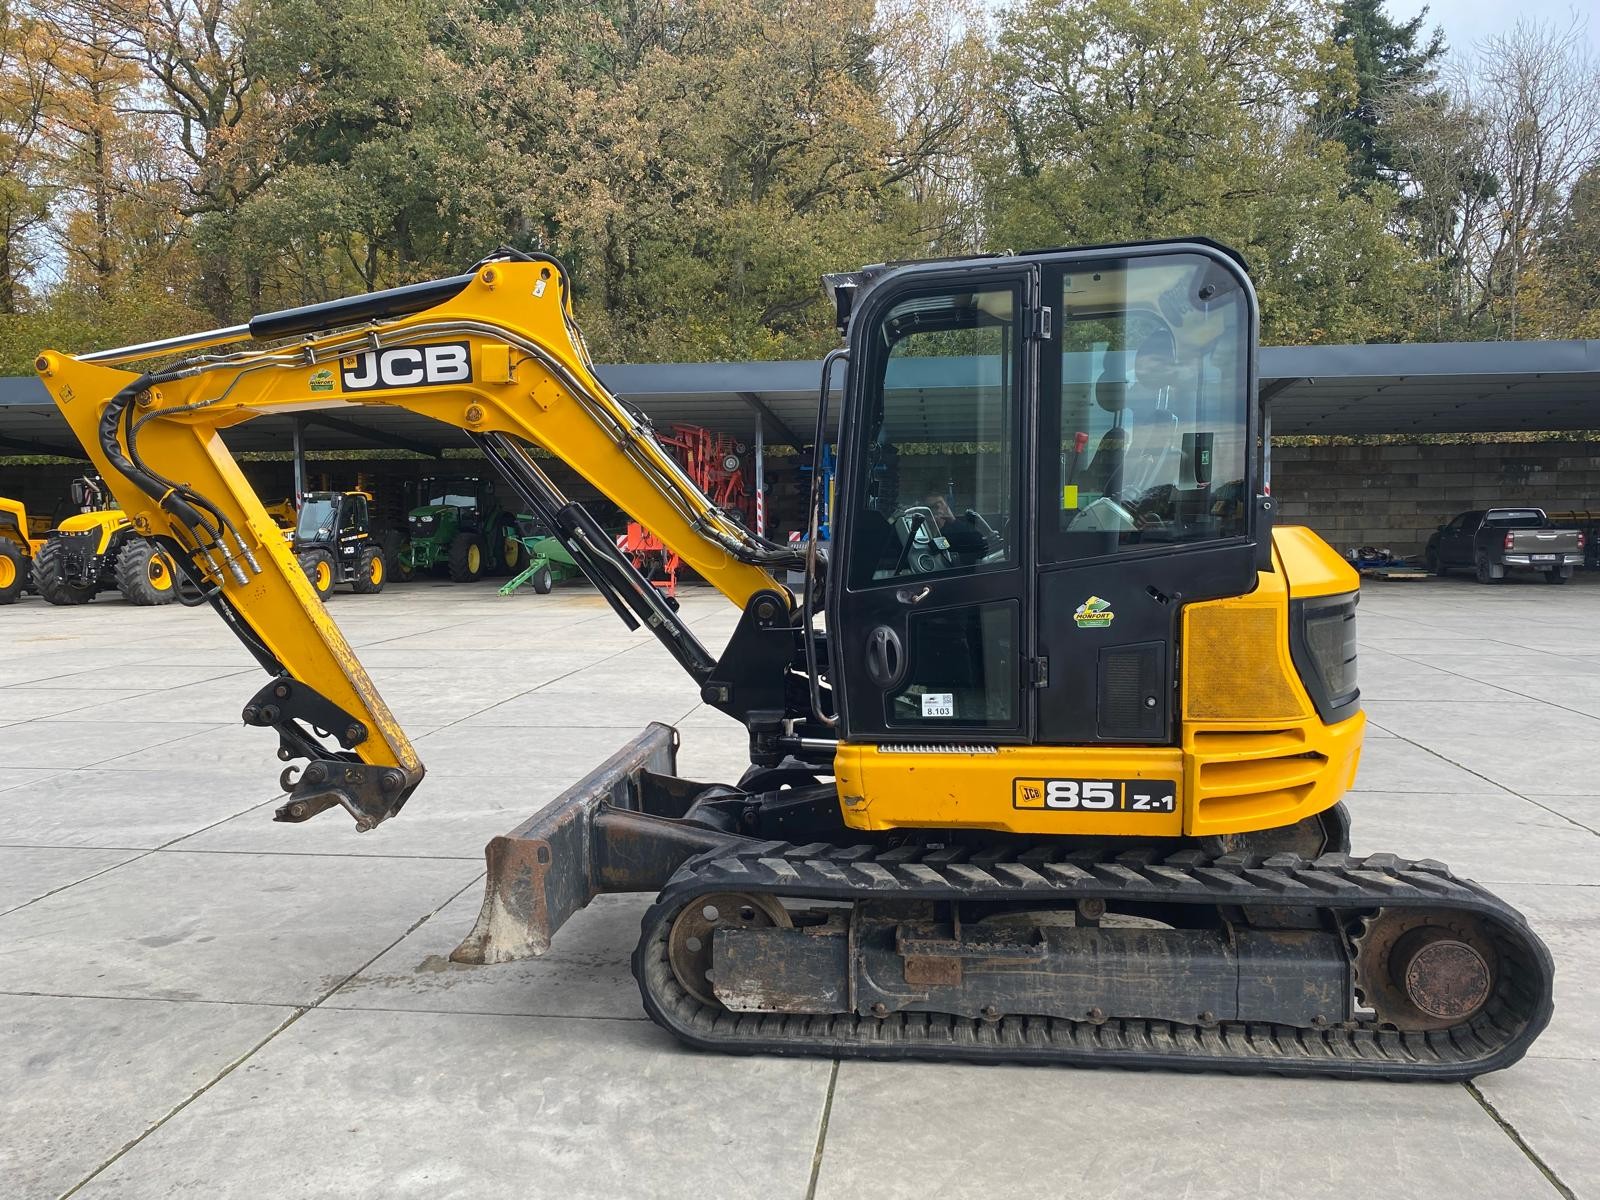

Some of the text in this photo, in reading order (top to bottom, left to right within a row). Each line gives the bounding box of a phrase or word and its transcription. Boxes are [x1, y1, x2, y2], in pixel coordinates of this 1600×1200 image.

[344, 345, 470, 388] JCB
[927, 707, 950, 715] 8.103
[1023, 781, 1174, 811] JCB 85 Z-1
